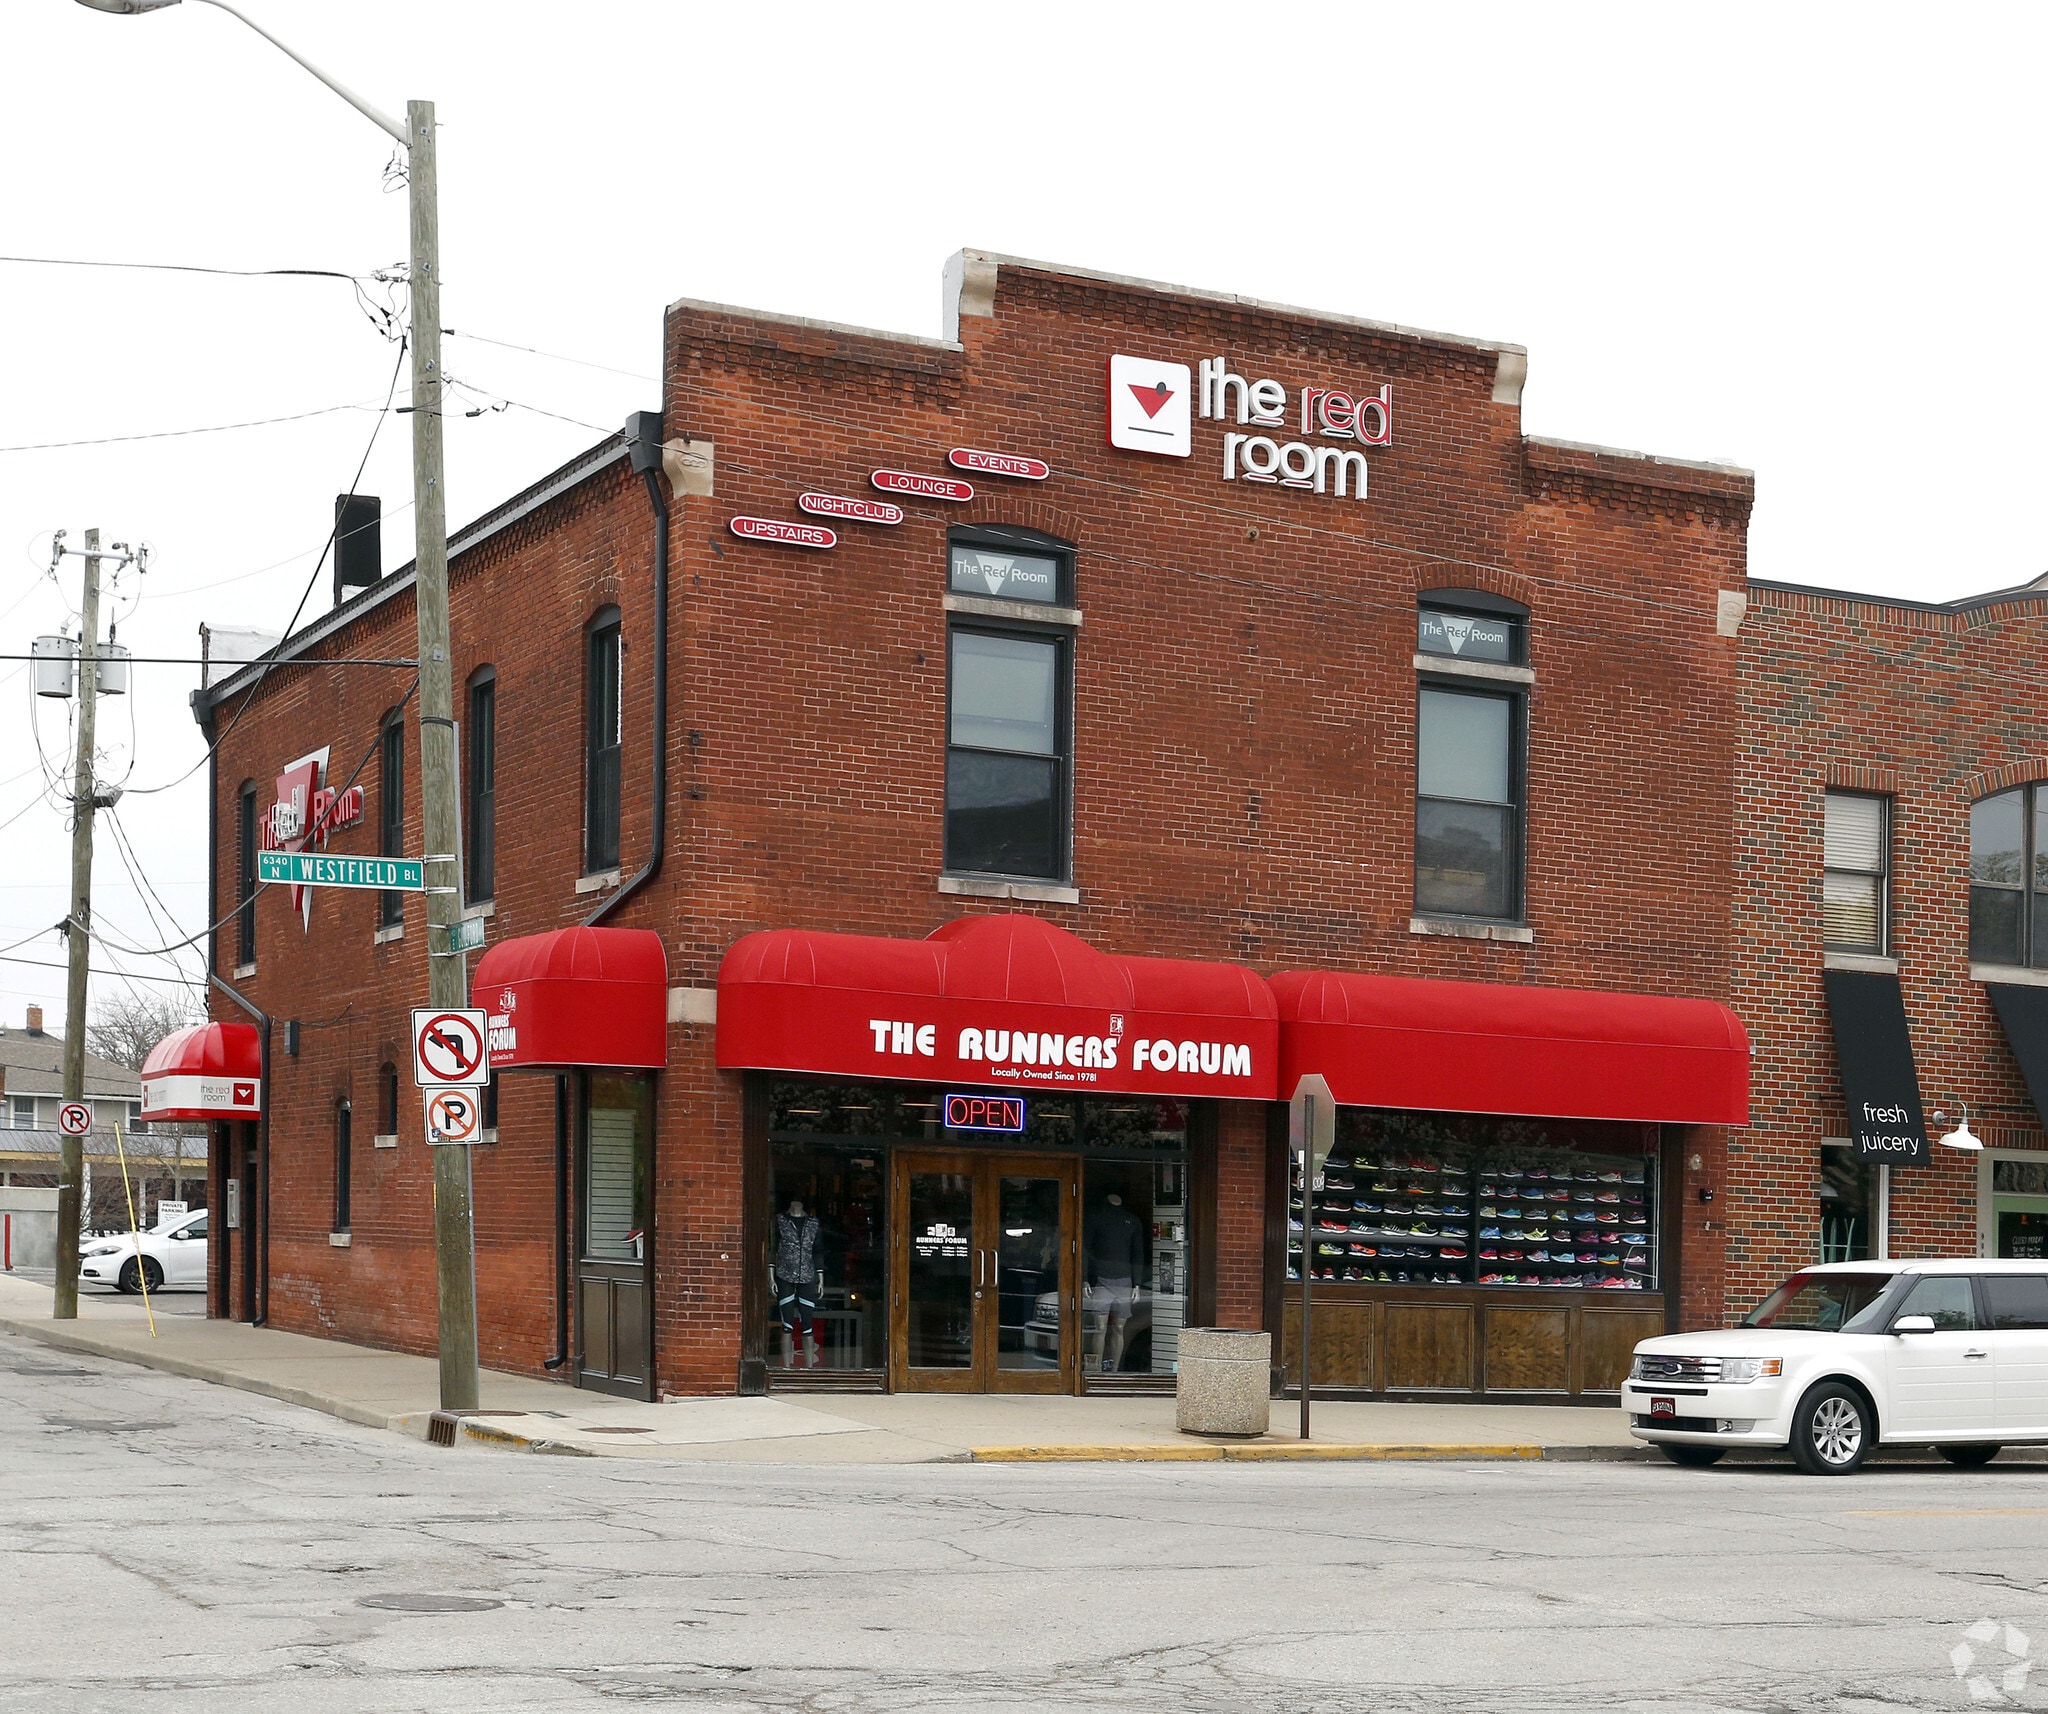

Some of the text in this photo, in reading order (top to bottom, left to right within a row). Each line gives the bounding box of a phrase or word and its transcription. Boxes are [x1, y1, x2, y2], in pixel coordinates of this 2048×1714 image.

[1199, 356, 1392, 447] the red
[967, 453, 1031, 474] EVENTS
[1223, 432, 1368, 500] room
[888, 475, 957, 496] LOUNGE
[804, 496, 898, 520] NIGHTCLUB
[742, 521, 824, 544] UPSTAIRS
[954, 559, 1048, 584] The Red Room
[1421, 621, 1504, 643] The Red Room
[263, 855, 288, 866] 6340
[271, 858, 418, 885] N WESTFIELD BL
[488, 1027, 517, 1052] FORUM
[869, 1019, 936, 1057] THE
[1132, 1039, 1252, 1077] FORUM
[991, 1066, 1097, 1082] Locally Owned Since 1978!
[948, 1097, 1020, 1127] OPEN
[1863, 1102, 1909, 1124] fresh
[1860, 1130, 1919, 1156] juicery
